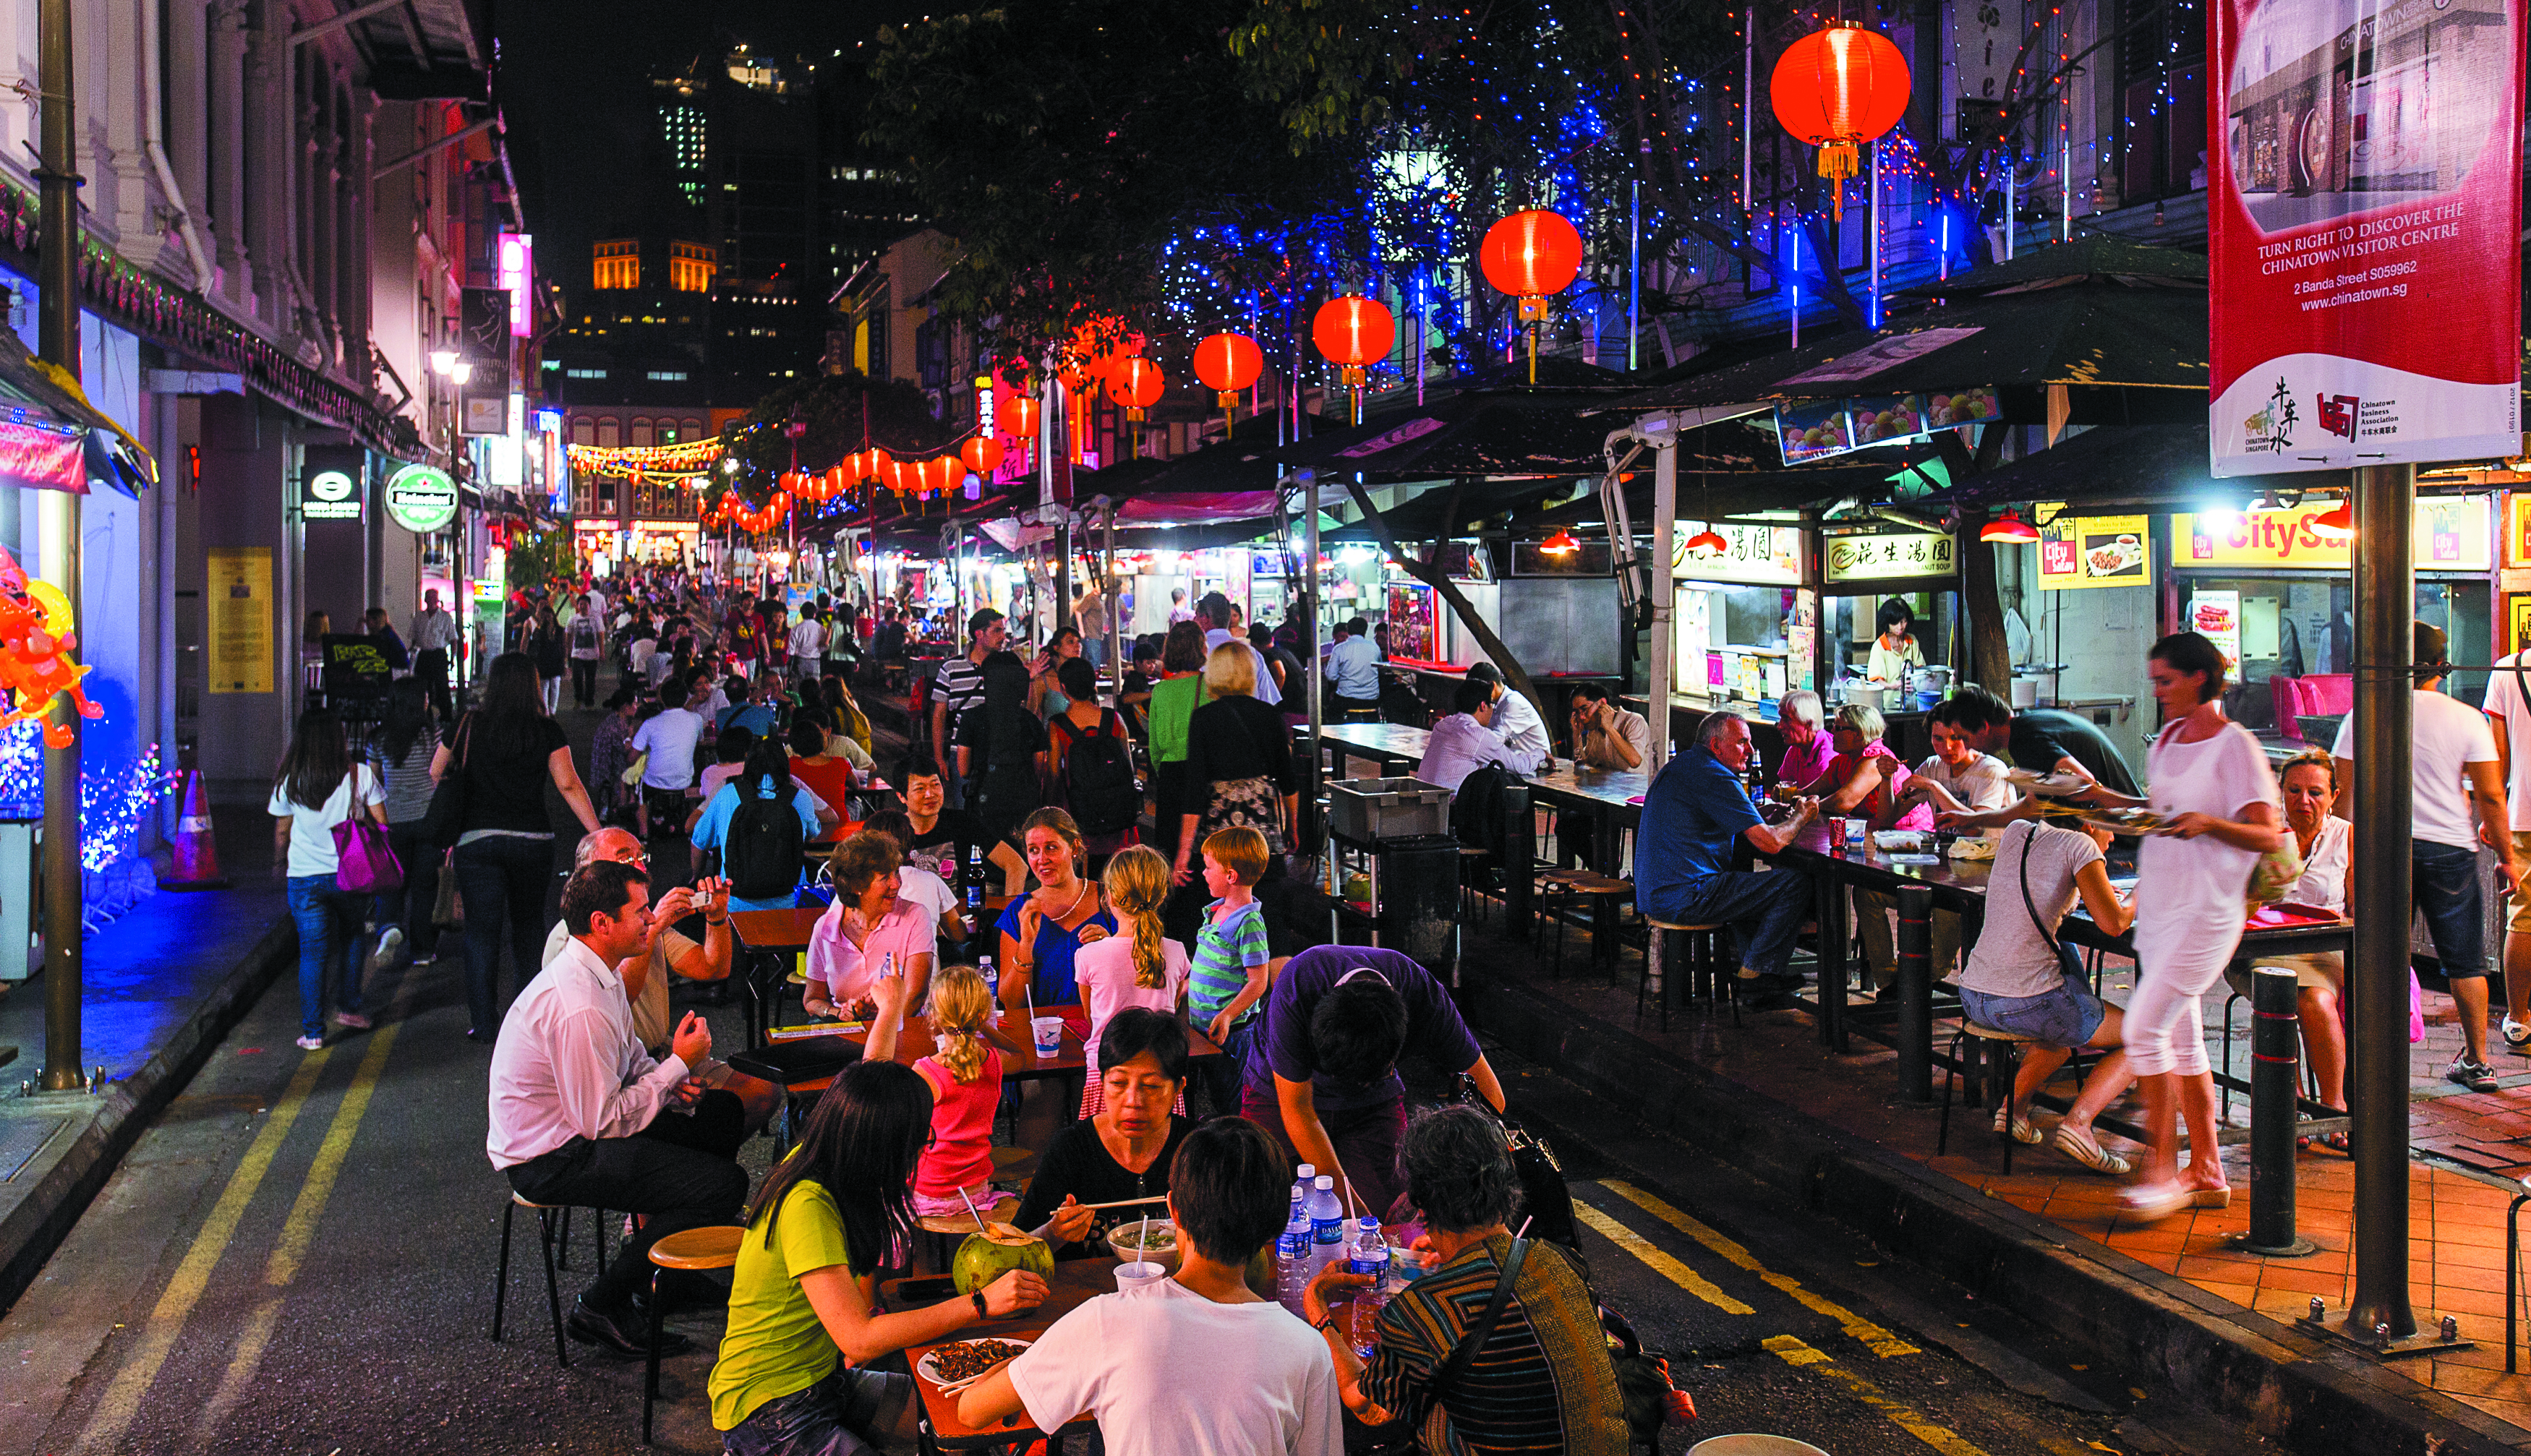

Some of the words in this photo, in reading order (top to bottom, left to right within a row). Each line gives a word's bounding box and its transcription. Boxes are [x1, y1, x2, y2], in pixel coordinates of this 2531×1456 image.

[2340, 5, 2407, 49] CHINATOWN
[2258, 241, 2291, 260] TURN
[2295, 231, 2335, 252] RIGHT
[2338, 226, 2354, 241] TO
[2360, 209, 2430, 237] DISCOVER
[2434, 202, 2464, 220] THE
[2262, 248, 2340, 275] CHINATOWN
[2342, 236, 2399, 257] VISITOR
[2401, 222, 2459, 246] CENTRE
[2294, 283, 2300, 295] 2
[2302, 278, 2334, 294] Banda
[2336, 272, 2367, 288] Street
[2370, 261, 2417, 280] S059962
[2301, 283, 2407, 312] www.chinatown.sg
[2361, 400, 2396, 409] Chinatown
[2361, 416, 2399, 425] Association
[2245, 437, 2269, 446] CHINATOWN
[2245, 445, 2268, 453] SINGAPORE
[396, 492, 451, 505] Heineken
[2194, 536, 2208, 549] City
[2436, 533, 2452, 550] City
[1857, 539, 1951, 565] 花生湯圓
[2045, 541, 2067, 561] City
[2441, 549, 2457, 560] Satay
[2052, 560, 2075, 573] Satay
[1712, 662, 1719, 677] A
